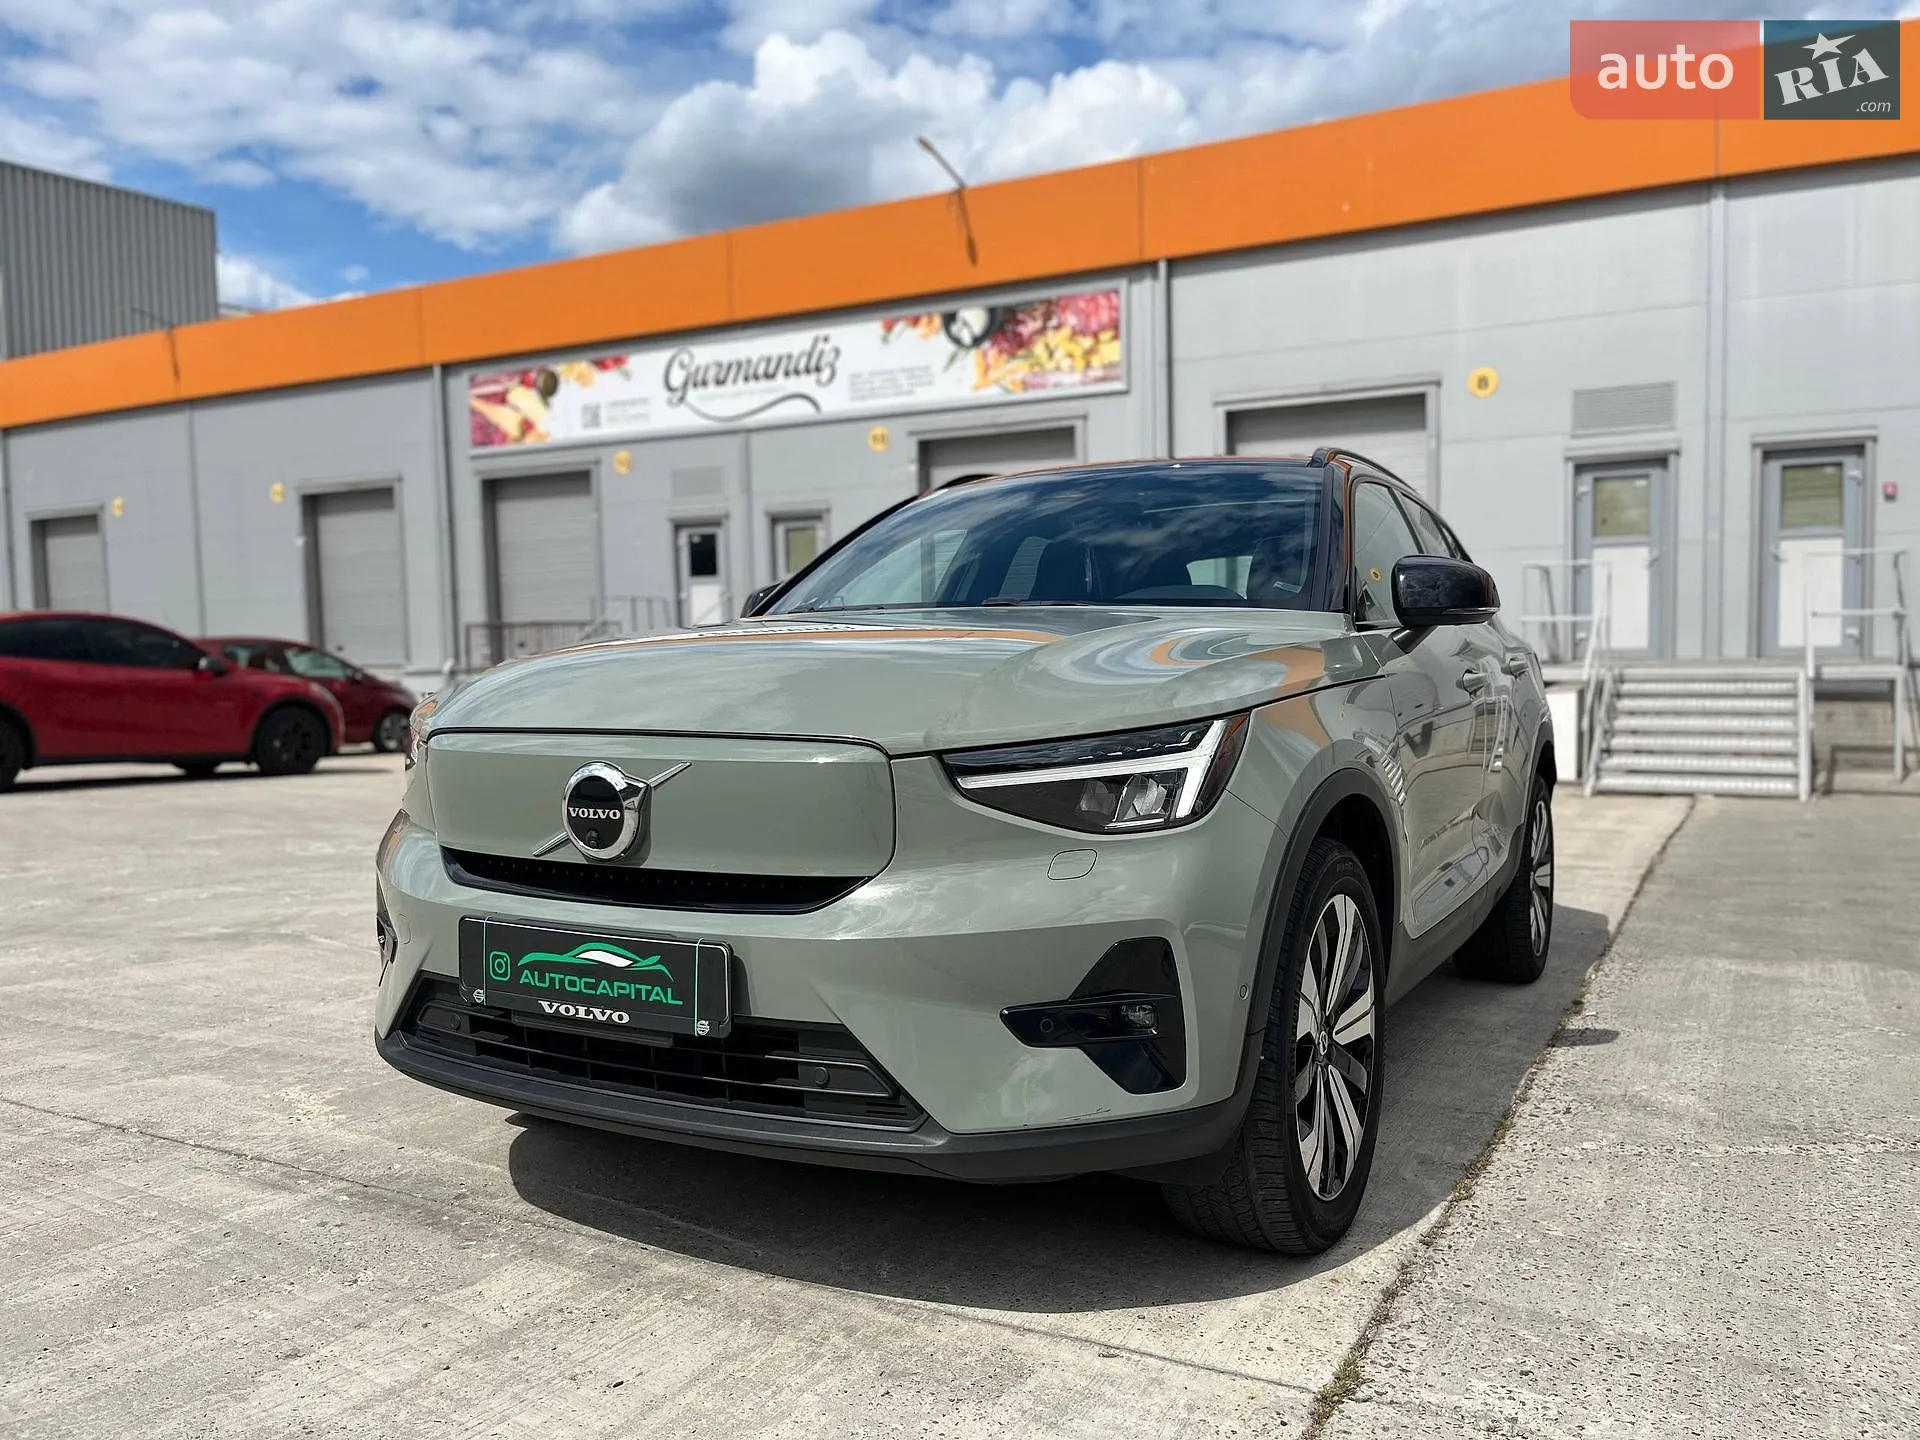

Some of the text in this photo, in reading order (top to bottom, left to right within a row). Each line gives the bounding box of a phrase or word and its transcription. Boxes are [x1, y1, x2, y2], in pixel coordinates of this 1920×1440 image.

[663, 334, 841, 407] Gurmandiz
[568, 806, 621, 820] VOLVO
[519, 969, 684, 1006] AUTOCAPITAL
[538, 1000, 631, 1024] VOLVO
